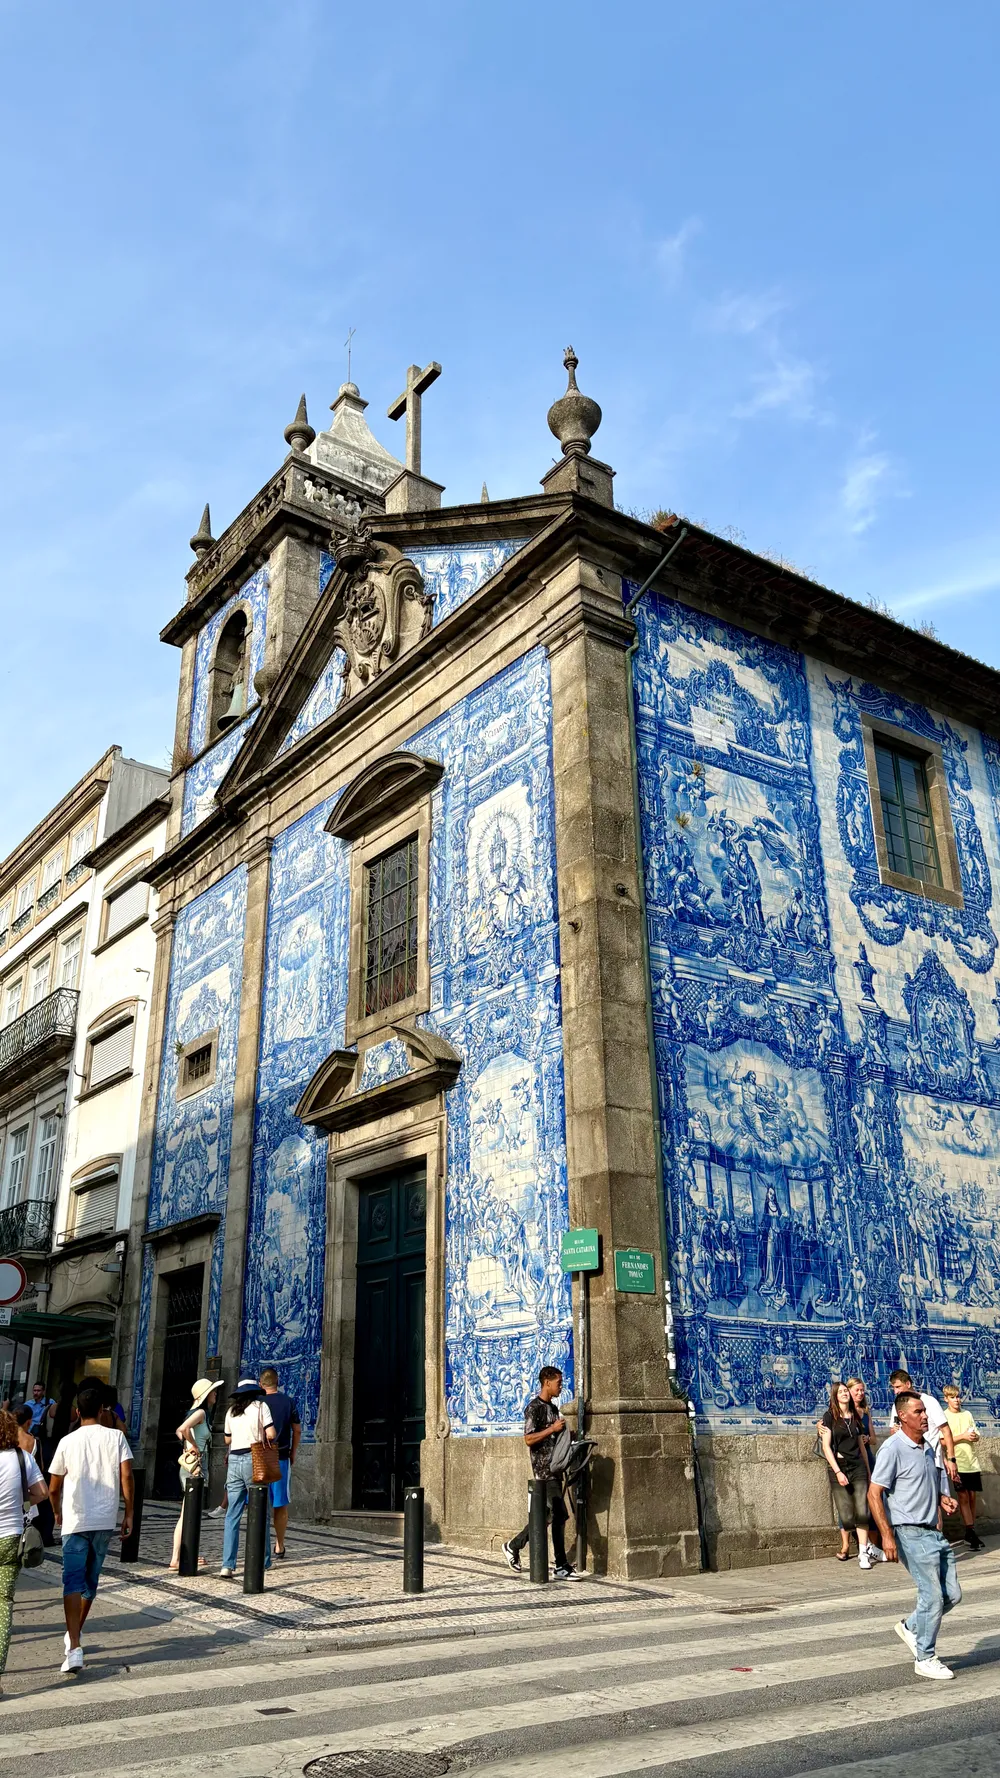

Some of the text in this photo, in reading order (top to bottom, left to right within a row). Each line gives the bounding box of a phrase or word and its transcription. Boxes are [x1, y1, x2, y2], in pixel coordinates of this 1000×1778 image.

[563, 1245, 596, 1255] SANTA CATARINA
[621, 1261, 649, 1271] FERNANDES
[628, 1269, 644, 1279] TOMÁS
